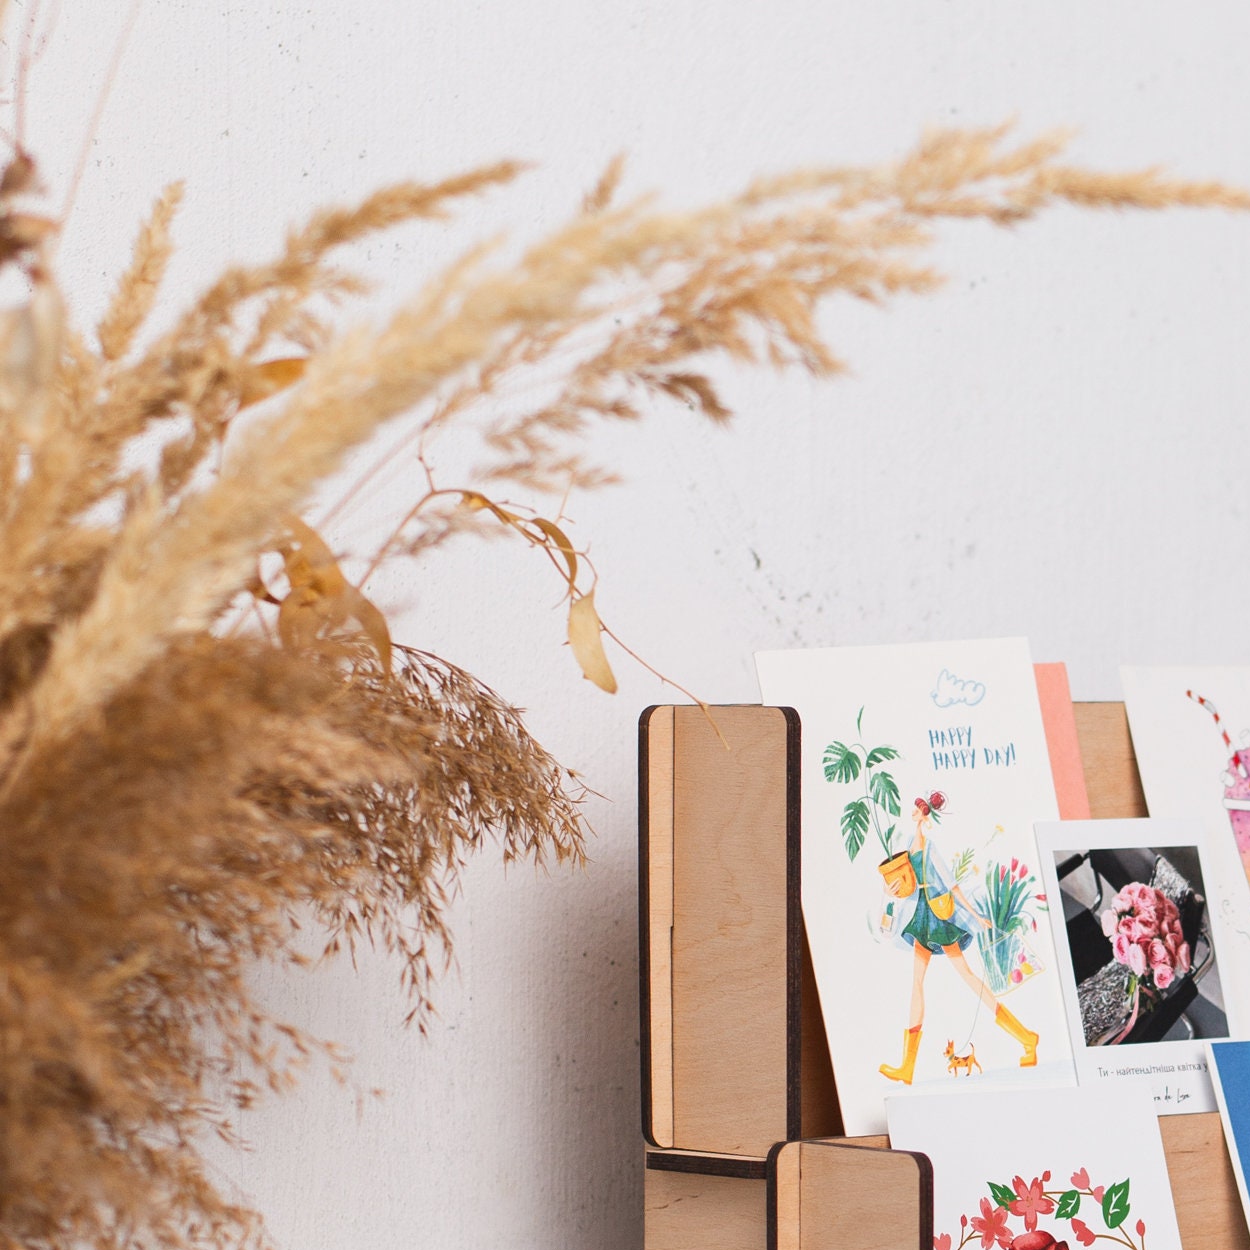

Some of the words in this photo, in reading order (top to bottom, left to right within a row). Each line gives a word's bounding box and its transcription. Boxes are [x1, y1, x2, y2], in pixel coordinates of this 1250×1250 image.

[929, 725, 972, 749] HAPPY
[932, 748, 976, 771] HAPPY
[983, 742, 1017, 767] DAY!
